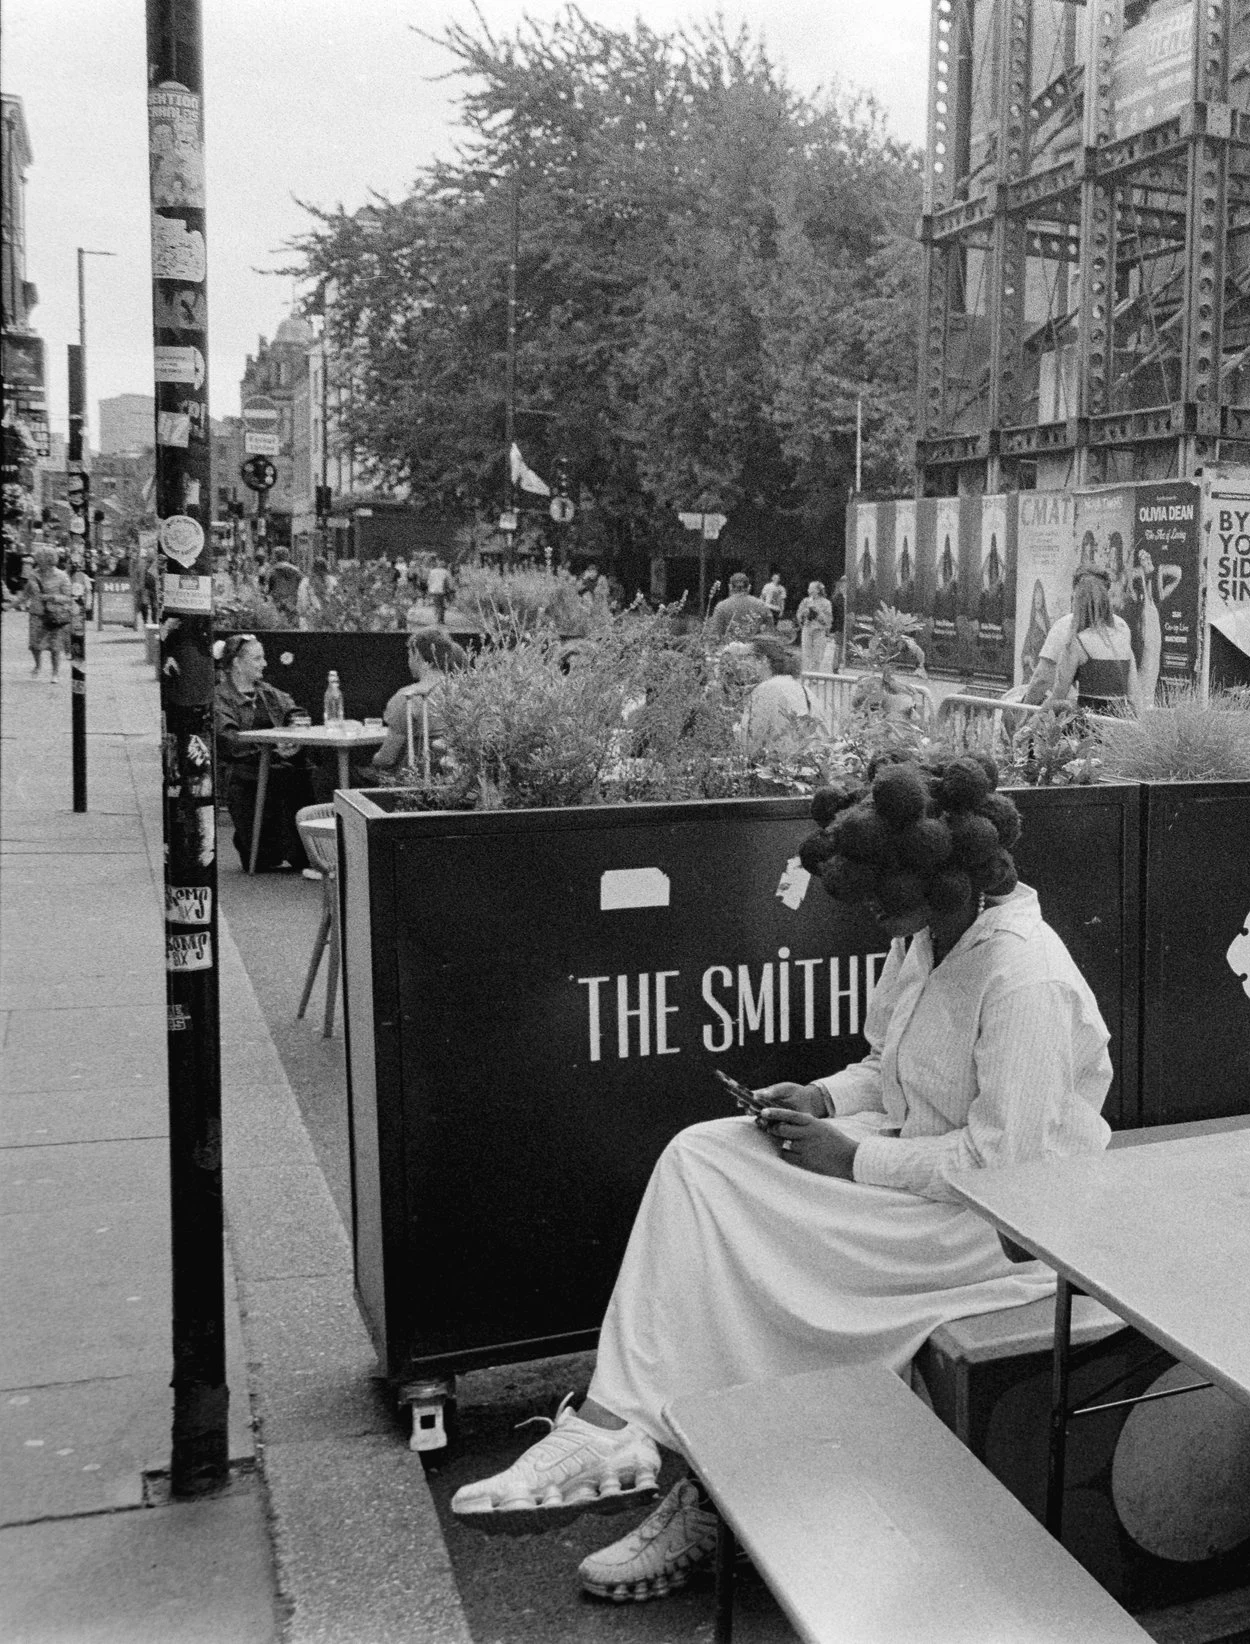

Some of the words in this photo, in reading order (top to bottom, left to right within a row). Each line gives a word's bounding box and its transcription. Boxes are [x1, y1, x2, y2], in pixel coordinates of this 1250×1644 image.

[1021, 498, 1071, 525] CMAT
[1139, 507, 1167, 522] OLIVIA
[1169, 505, 1194, 520] DEAN
[1220, 510, 1250, 532] BY
[578, 970, 681, 1062] THE
